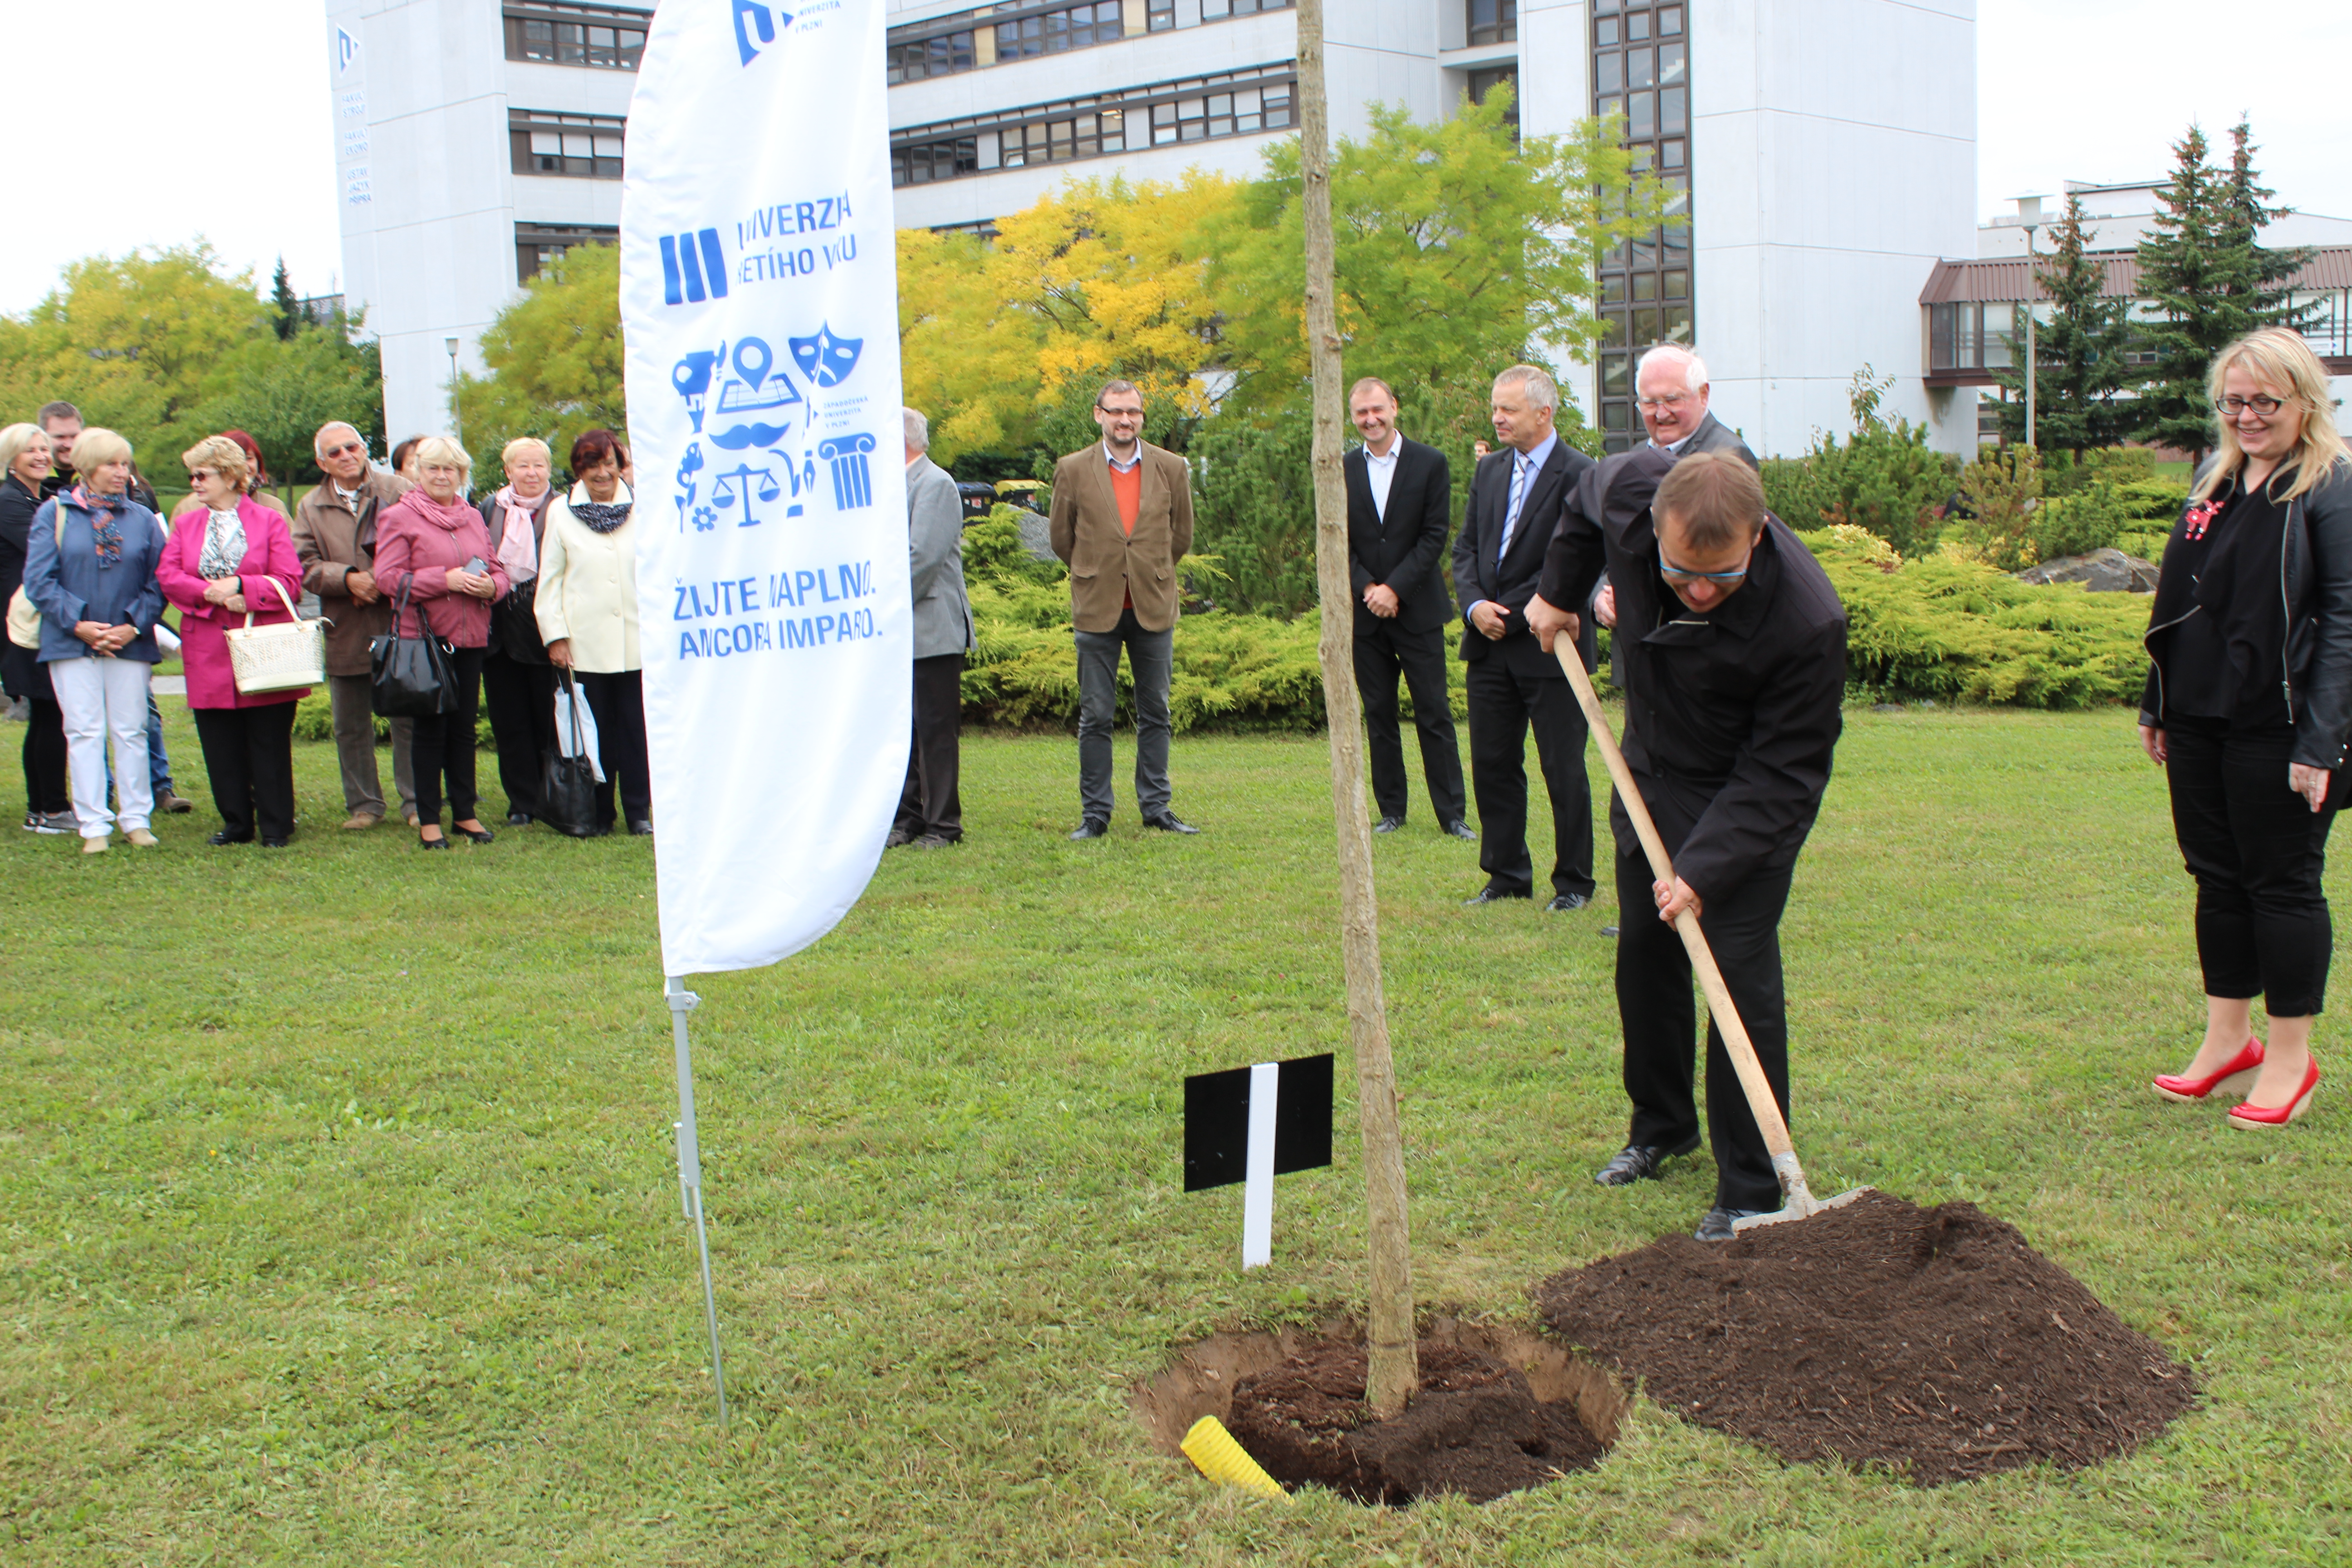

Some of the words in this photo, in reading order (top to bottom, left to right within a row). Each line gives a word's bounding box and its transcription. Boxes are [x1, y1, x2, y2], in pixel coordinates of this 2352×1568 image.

[824, 407, 862, 418] UNIVERZITA
[674, 577, 760, 620] ŽIJTE
[779, 608, 883, 650] IMPARO.
